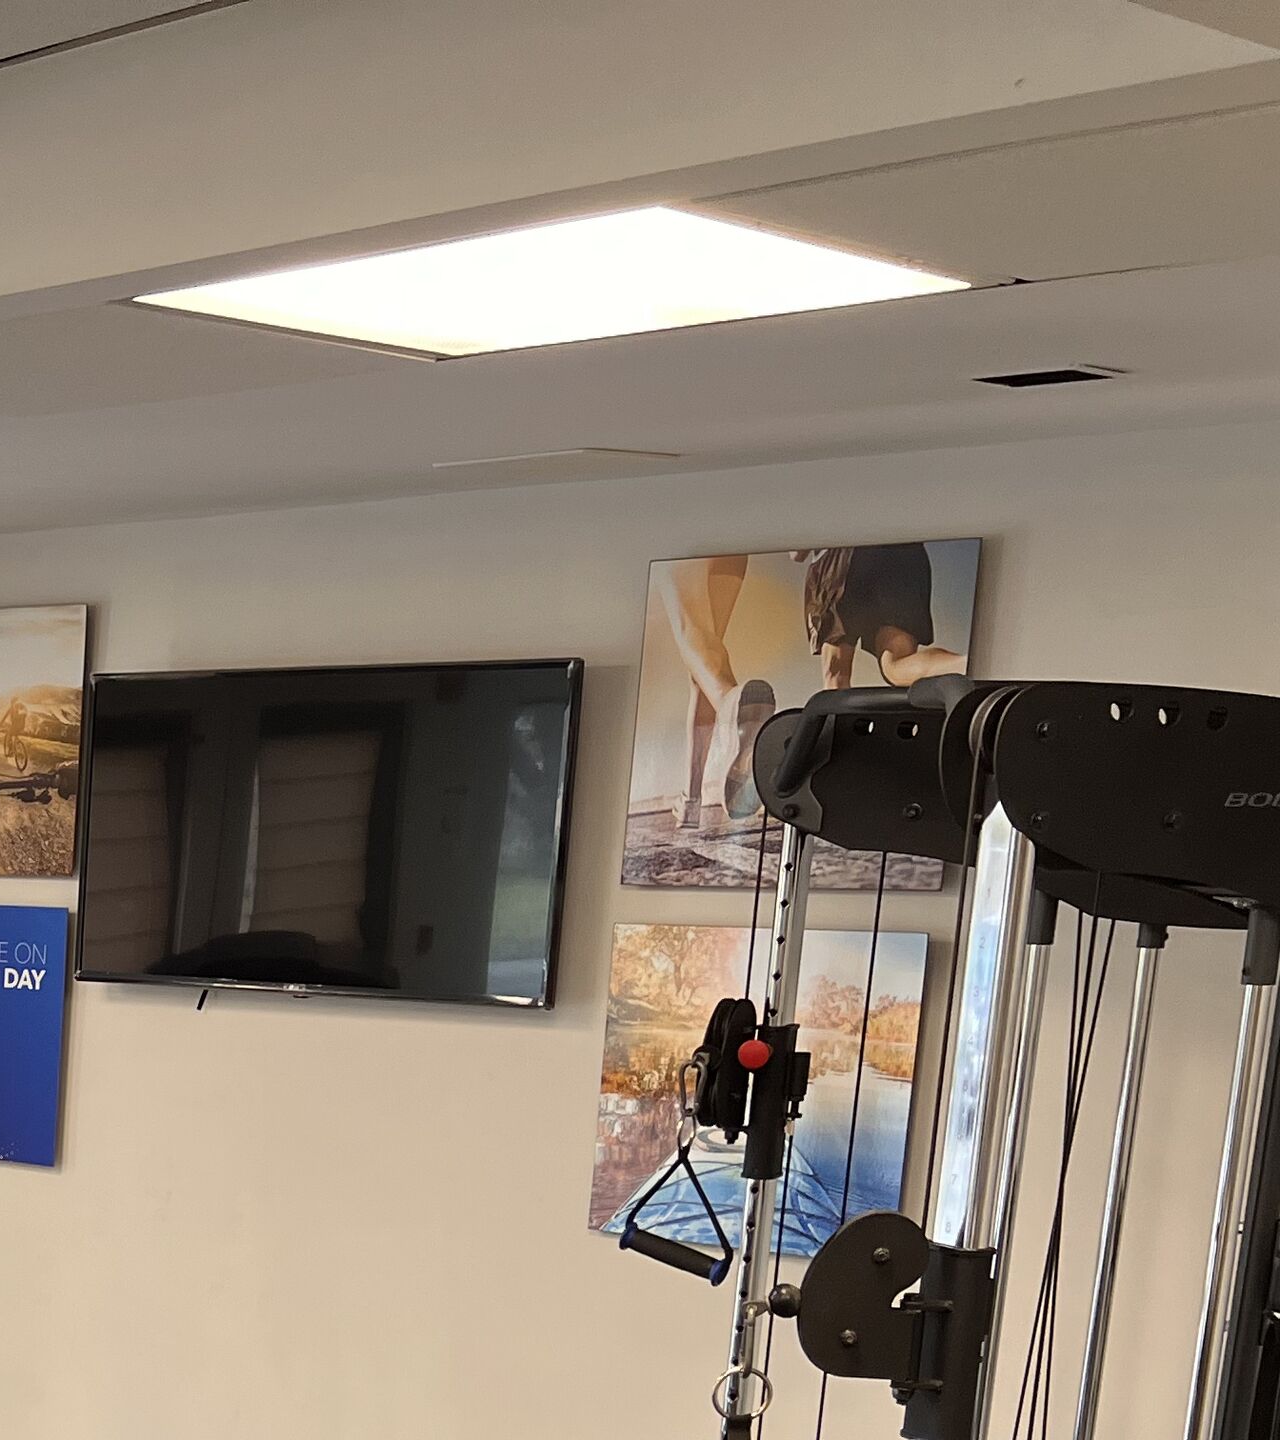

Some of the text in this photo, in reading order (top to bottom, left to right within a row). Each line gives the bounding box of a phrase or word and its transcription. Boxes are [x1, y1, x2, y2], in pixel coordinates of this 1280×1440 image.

[979, 936, 986, 949] 2
[14, 942, 48, 965] ON
[3, 968, 46, 991] DAY
[972, 986, 980, 998] 3
